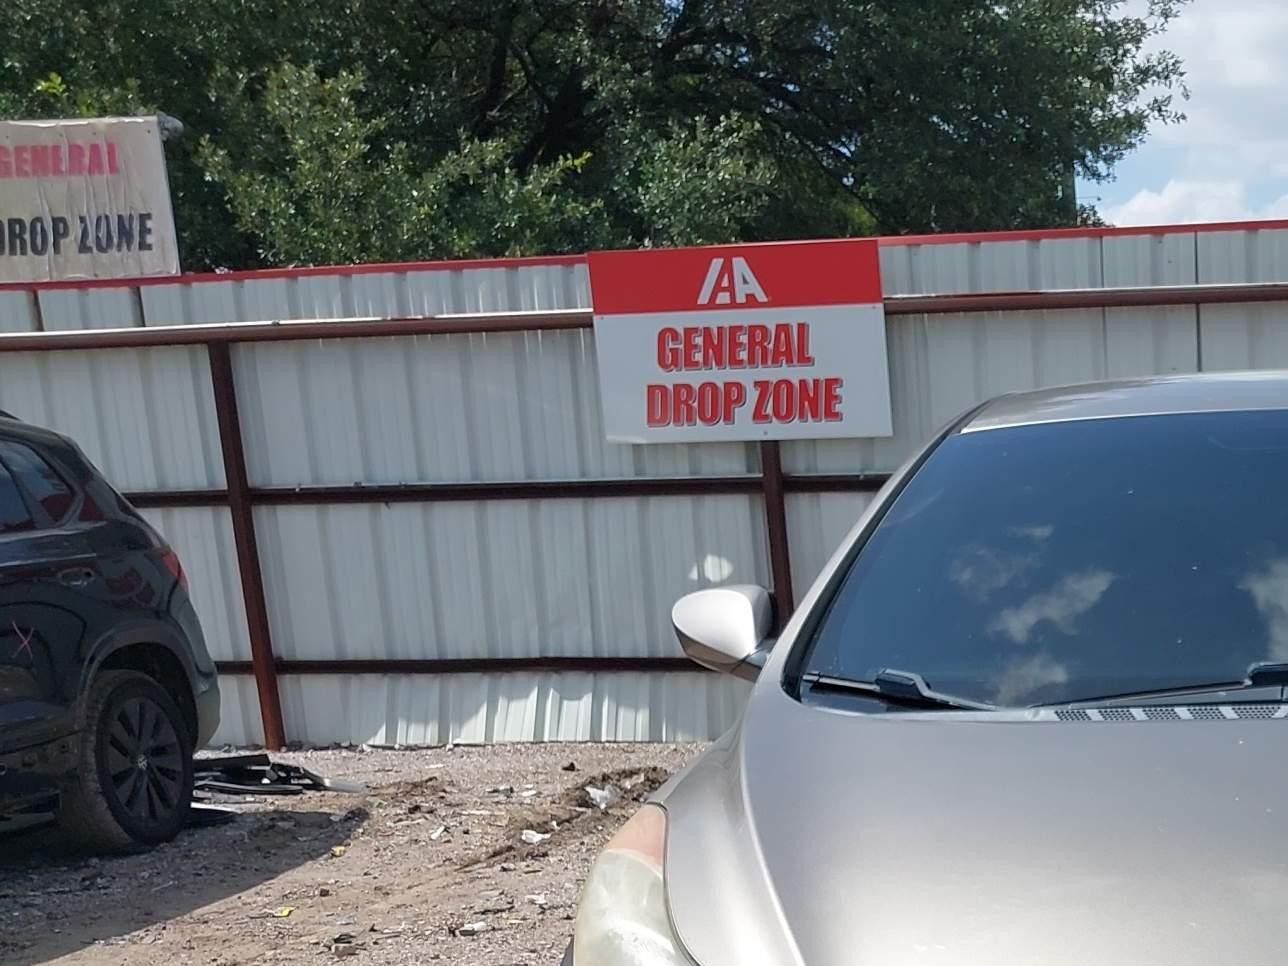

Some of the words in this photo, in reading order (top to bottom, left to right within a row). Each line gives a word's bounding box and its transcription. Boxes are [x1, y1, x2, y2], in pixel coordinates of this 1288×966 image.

[0, 143, 120, 178] GENERAL
[0, 215, 70, 257] ROP
[78, 212, 153, 254] ZONE
[656, 321, 815, 373] GENERAL
[646, 380, 747, 428] DROP
[751, 377, 844, 425] ZONE
